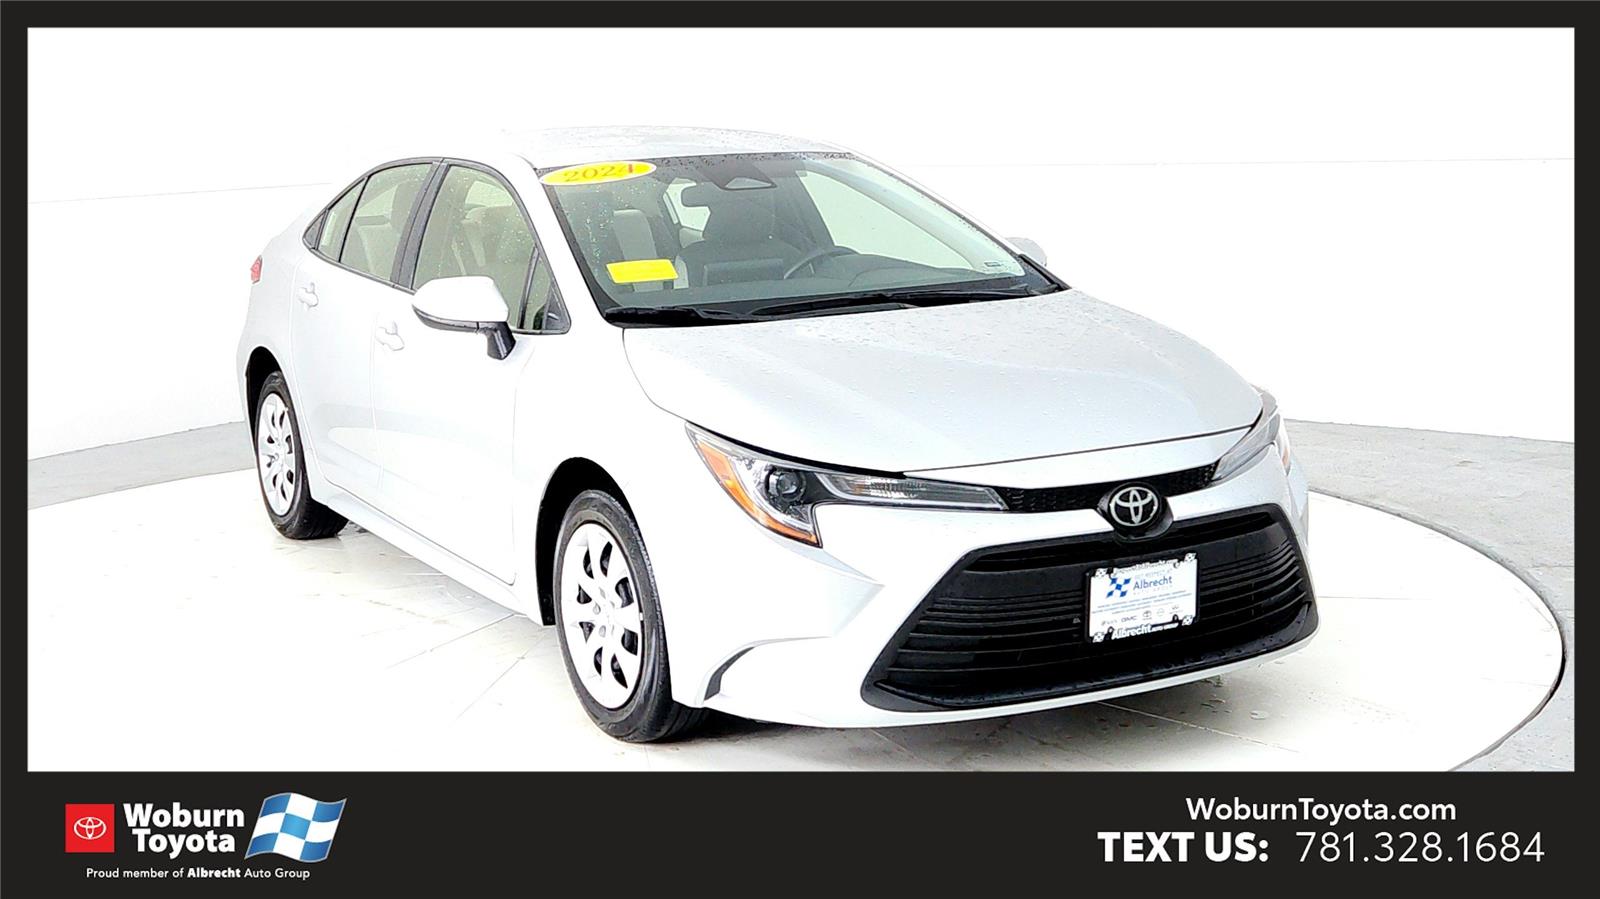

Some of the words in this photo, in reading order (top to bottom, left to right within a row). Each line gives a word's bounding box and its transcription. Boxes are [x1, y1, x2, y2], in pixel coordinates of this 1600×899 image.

[563, 163, 635, 183] 2024
[1133, 575, 1173, 591] Albrecht
[1111, 623, 1152, 640] Albrecht
